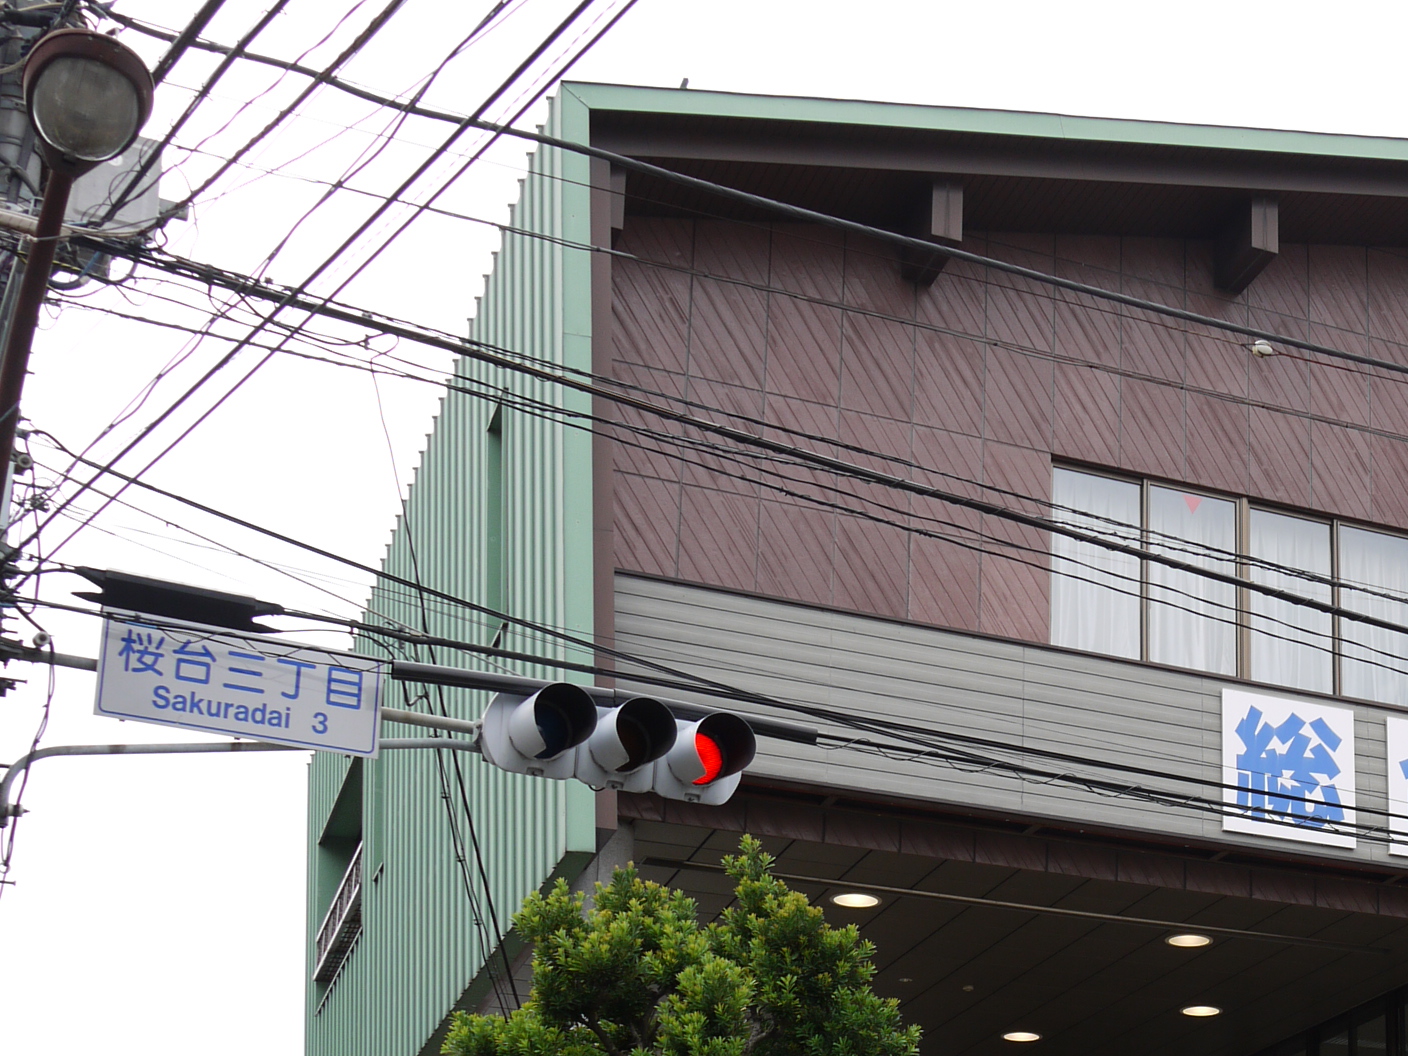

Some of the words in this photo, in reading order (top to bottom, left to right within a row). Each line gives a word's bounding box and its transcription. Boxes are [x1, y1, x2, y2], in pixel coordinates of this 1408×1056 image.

[118, 628, 363, 710] 桜台三丁目
[152, 685, 291, 729] Sakuradai
[312, 712, 329, 735] 3
